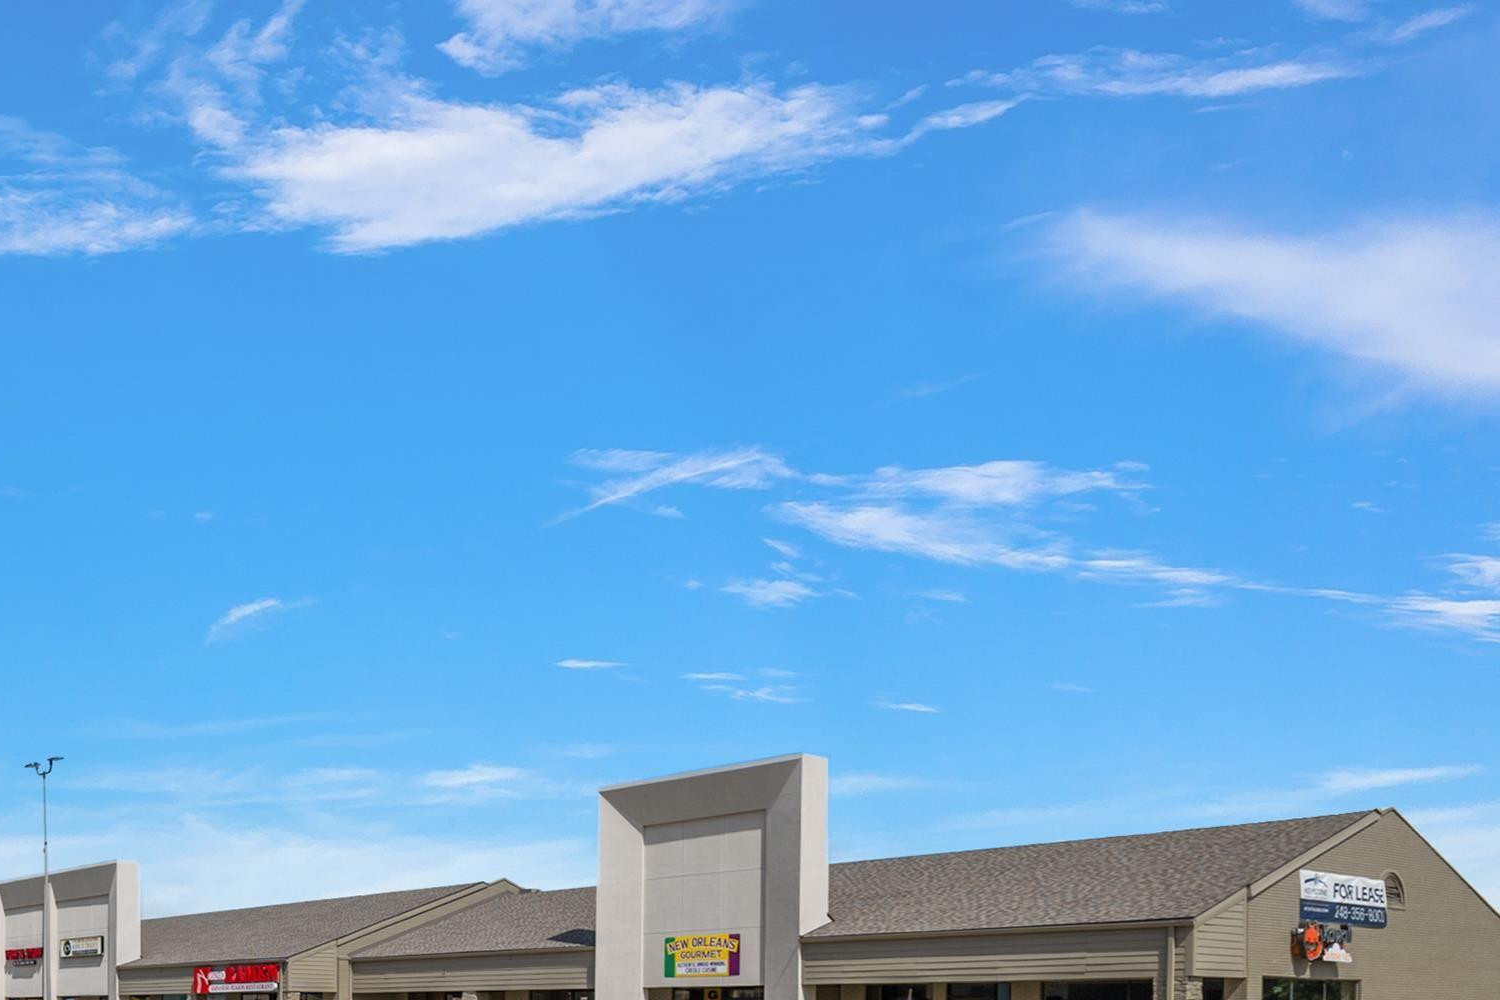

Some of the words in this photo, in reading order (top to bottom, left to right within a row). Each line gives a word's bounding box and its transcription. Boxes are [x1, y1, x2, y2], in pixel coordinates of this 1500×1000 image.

[1333, 883, 1354, 899] FOR
[1356, 886, 1385, 903] LEASE
[668, 939, 688, 952] NEW
[692, 937, 736, 950] ORLEANS
[680, 950, 722, 959] GOURMET
